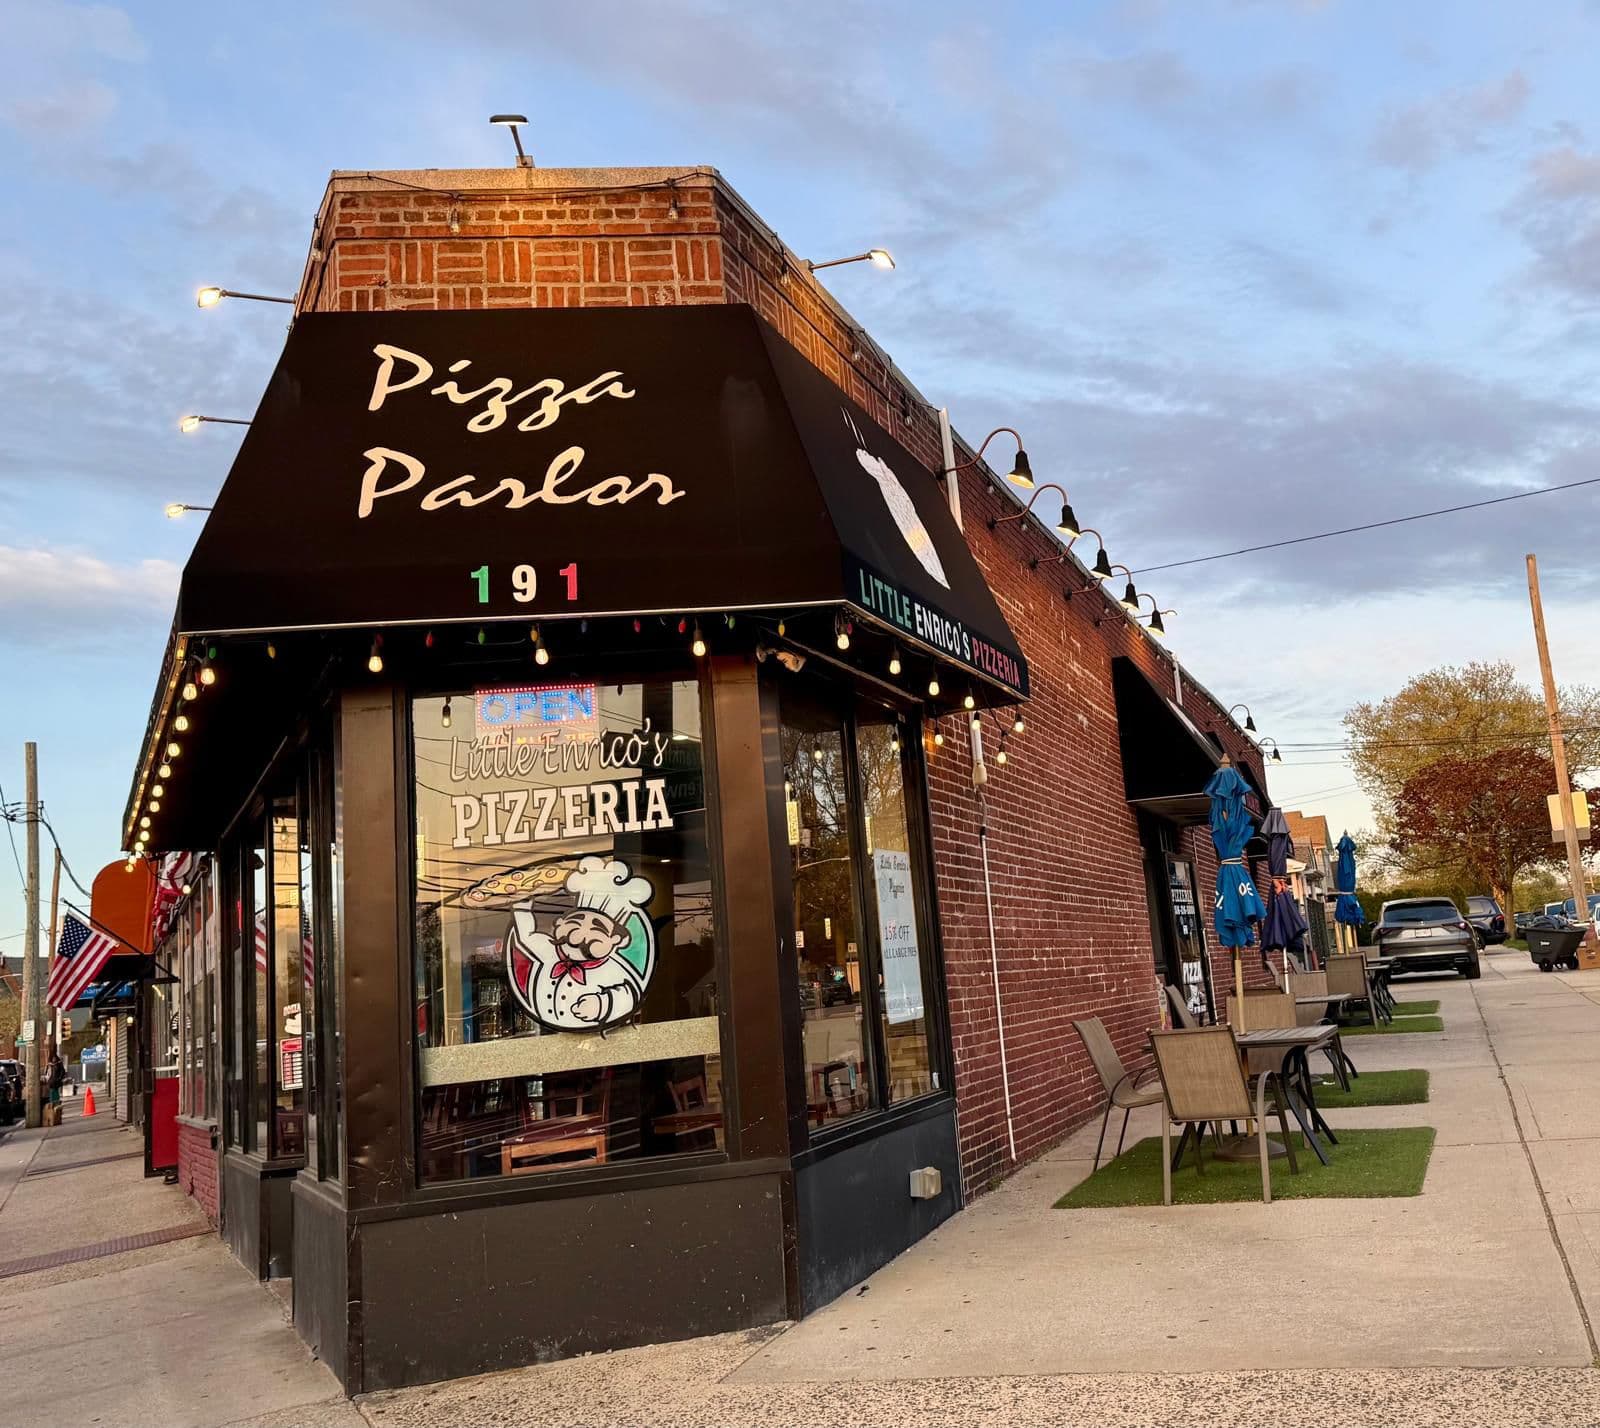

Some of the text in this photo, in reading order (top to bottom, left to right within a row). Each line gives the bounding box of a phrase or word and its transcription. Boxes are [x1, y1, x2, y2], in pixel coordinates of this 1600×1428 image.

[368, 344, 636, 433] Pizza
[358, 446, 686, 519] Parlor
[859, 568, 1021, 689] LITTLE ENRICO'S PIZZERIA
[482, 688, 593, 723] OPEN
[451, 717, 669, 782] Little Enrico's
[451, 777, 674, 848] PIZZERIA
[898, 925, 910, 941] OFF
